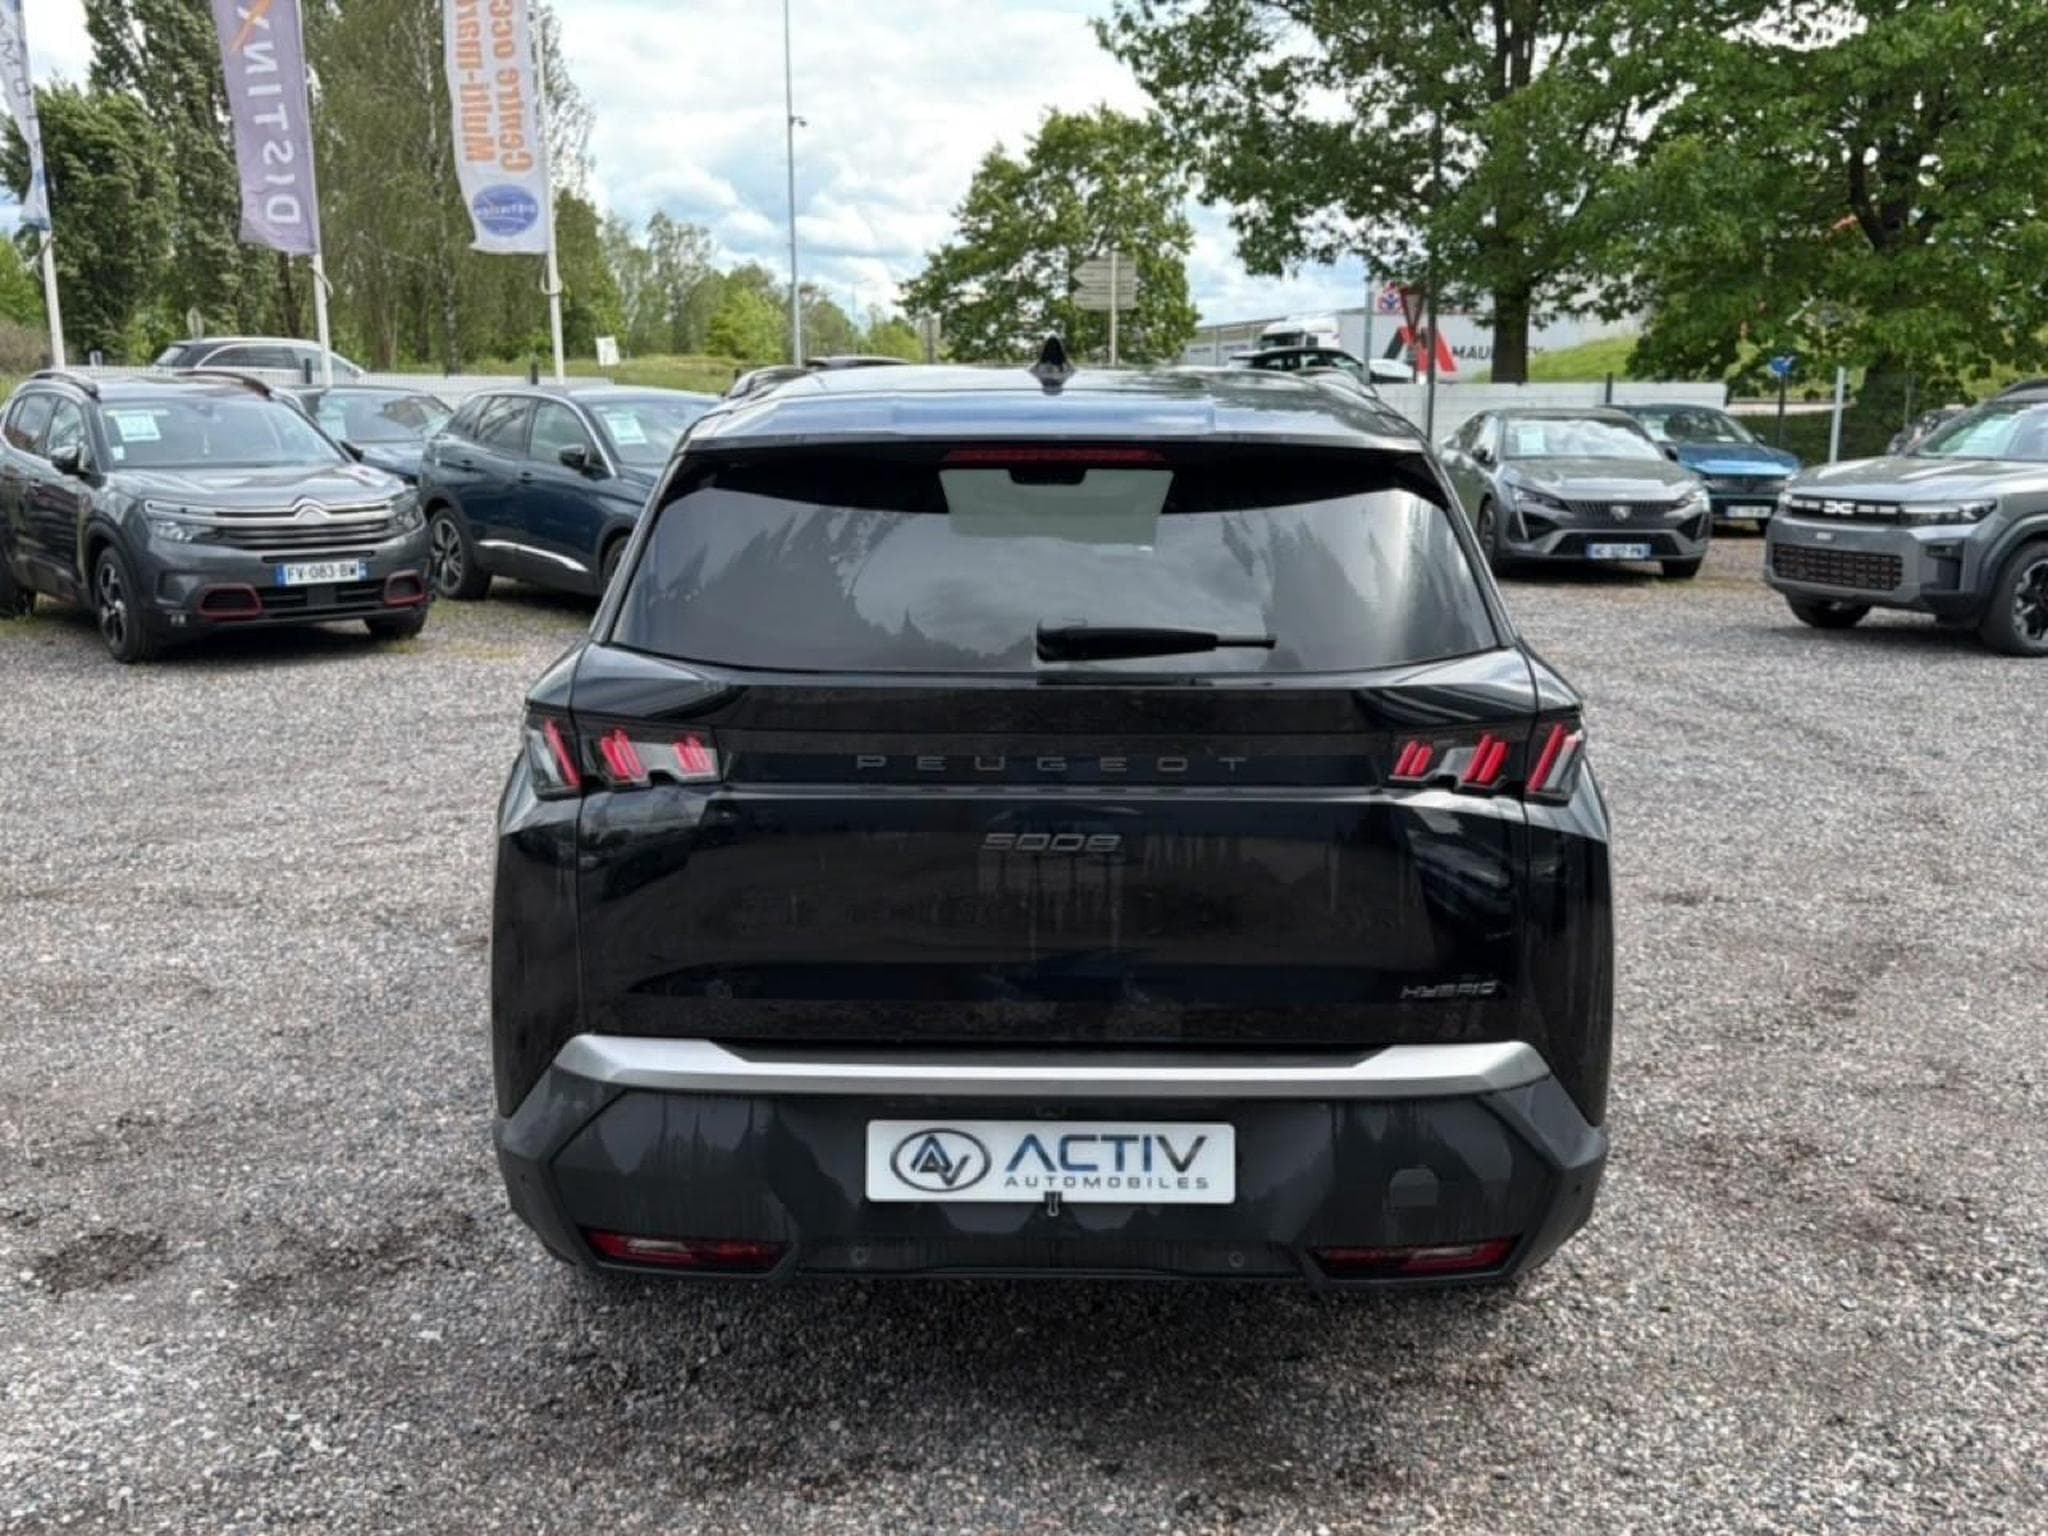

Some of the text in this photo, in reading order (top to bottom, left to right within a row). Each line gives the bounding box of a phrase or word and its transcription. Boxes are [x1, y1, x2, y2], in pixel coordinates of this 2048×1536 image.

[856, 756, 1247, 772] PEUGEOT
[980, 832, 1122, 852] 5008
[1004, 1133, 1208, 1173] ACTIV
[1004, 1176, 1209, 1190] AUTOMOBILES
